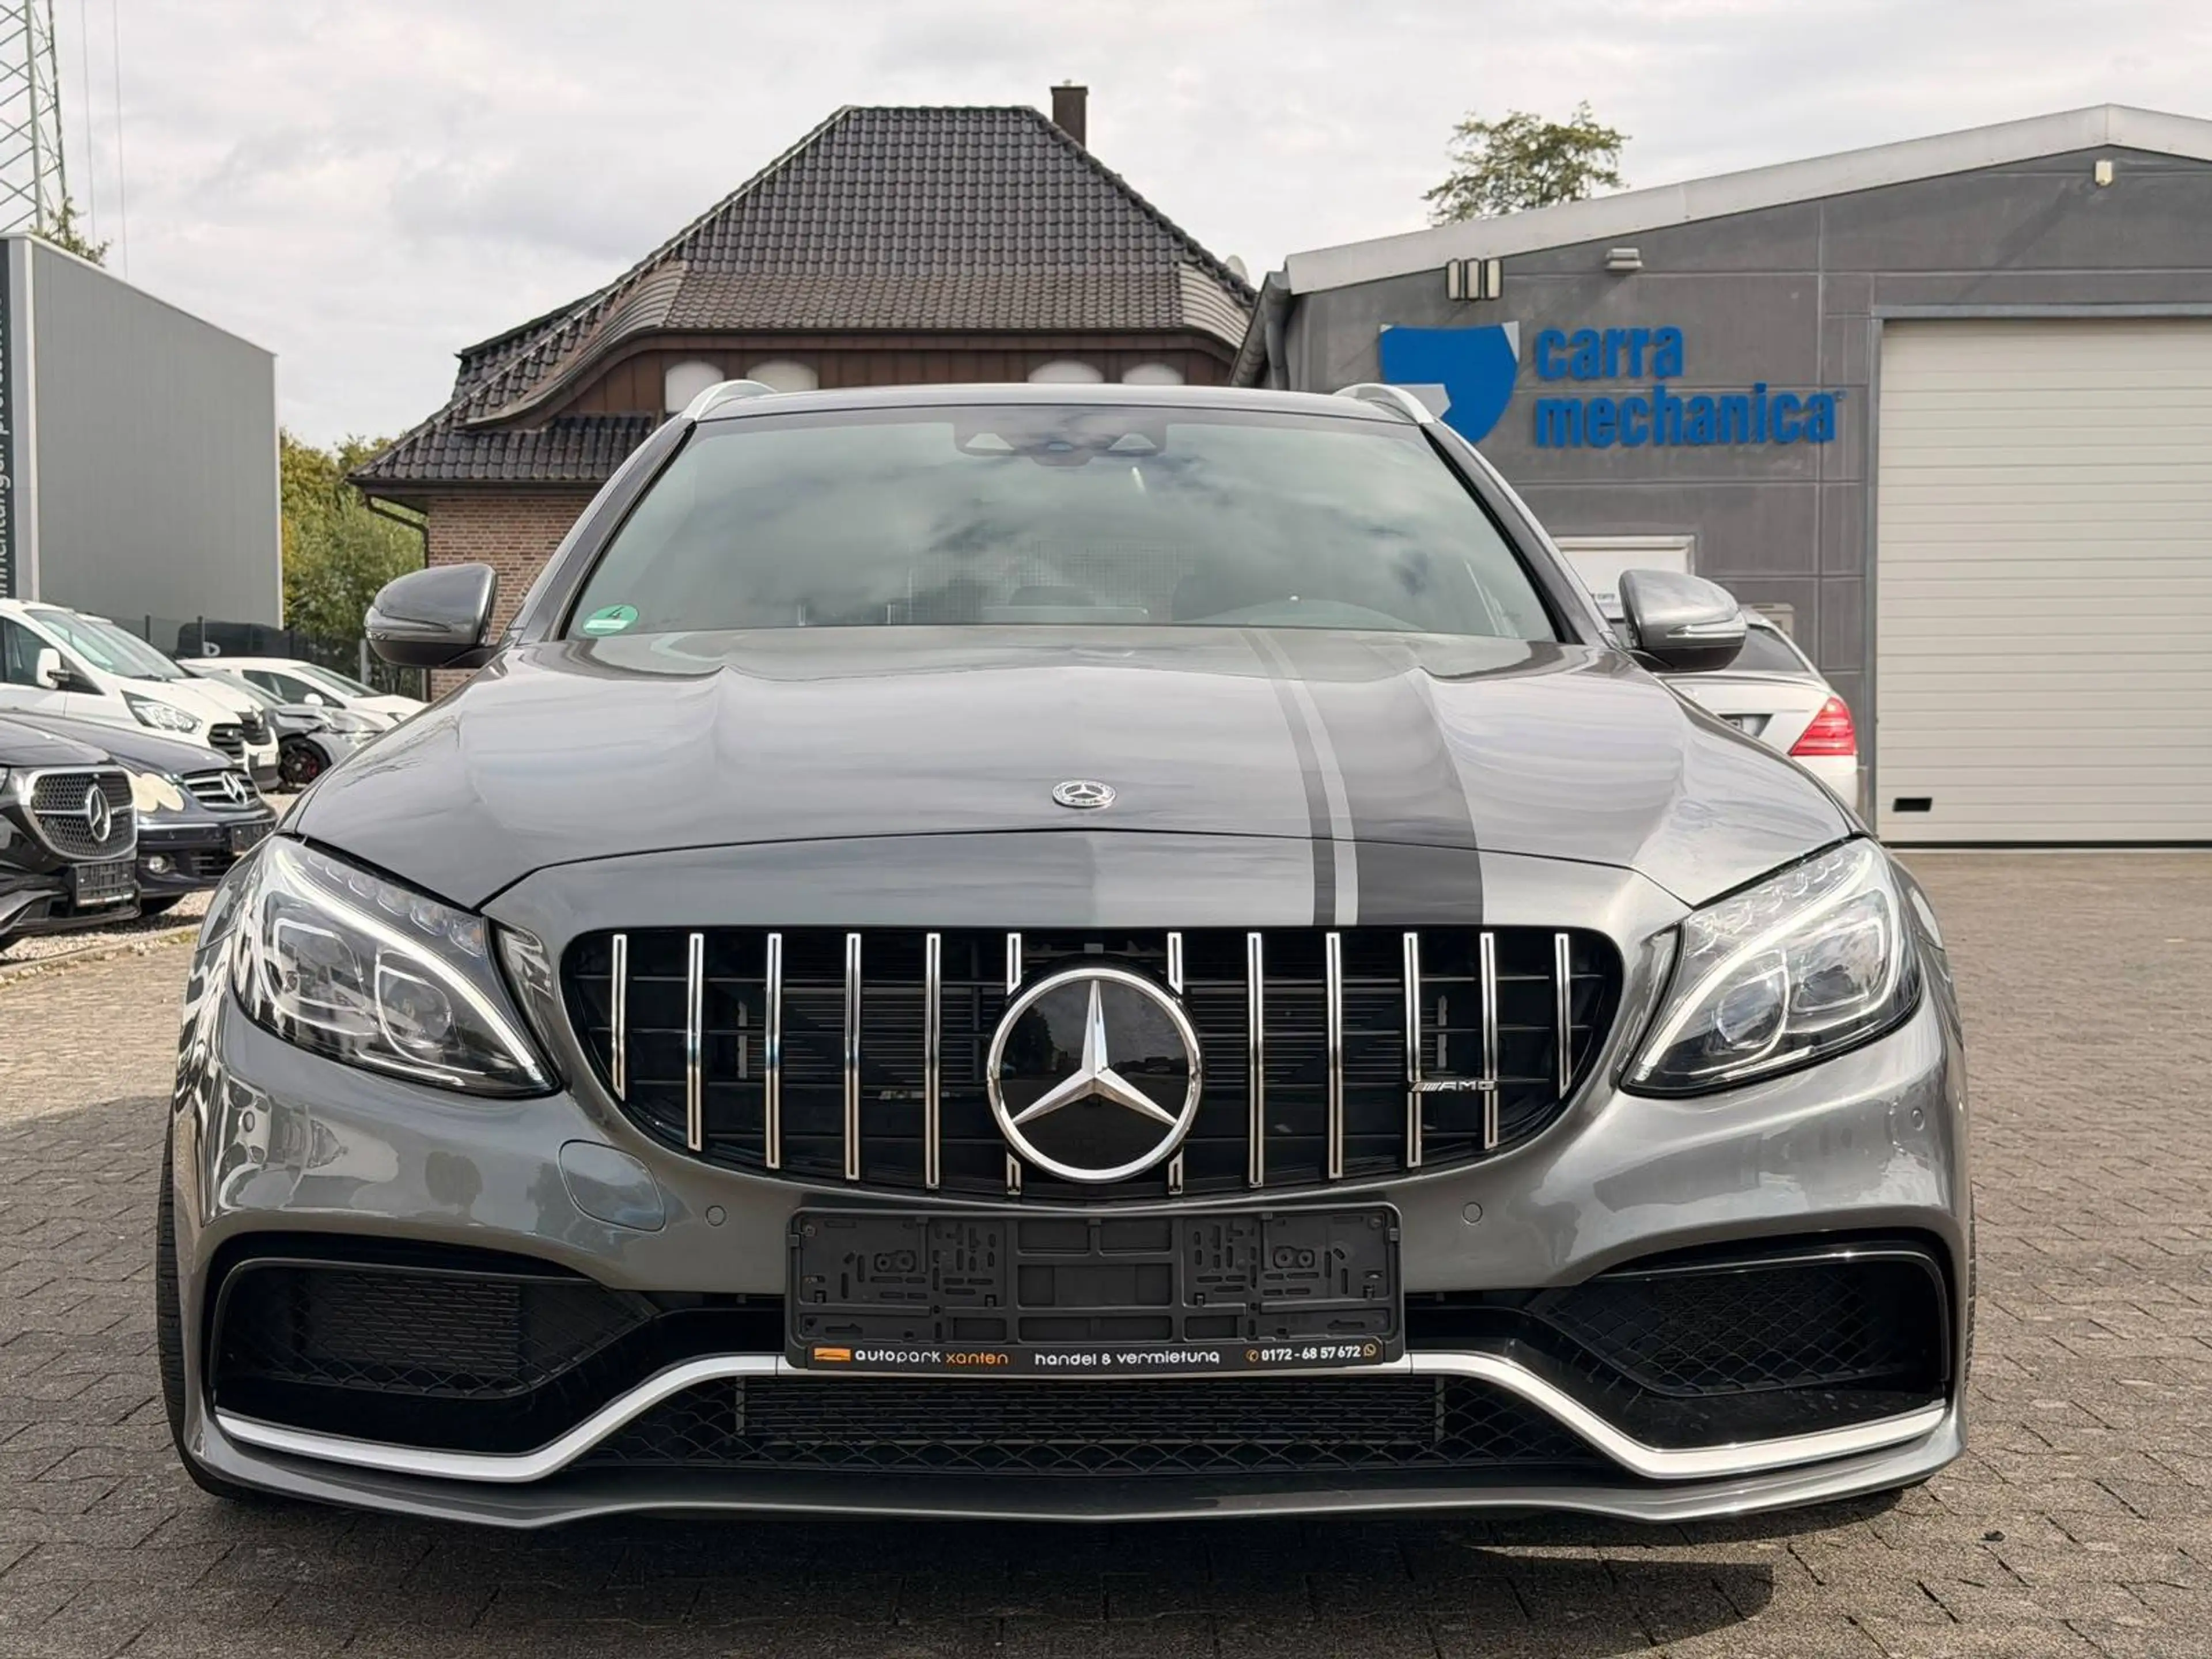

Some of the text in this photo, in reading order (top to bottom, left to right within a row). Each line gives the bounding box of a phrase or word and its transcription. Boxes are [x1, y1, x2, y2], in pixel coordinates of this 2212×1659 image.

[1536, 325, 1683, 381] carra
[1535, 382, 1835, 448] mechanica
[855, 1350, 1008, 1364] autopark xanten
[1035, 1353, 1096, 1365] handel
[1117, 1350, 1219, 1364] vermietung
